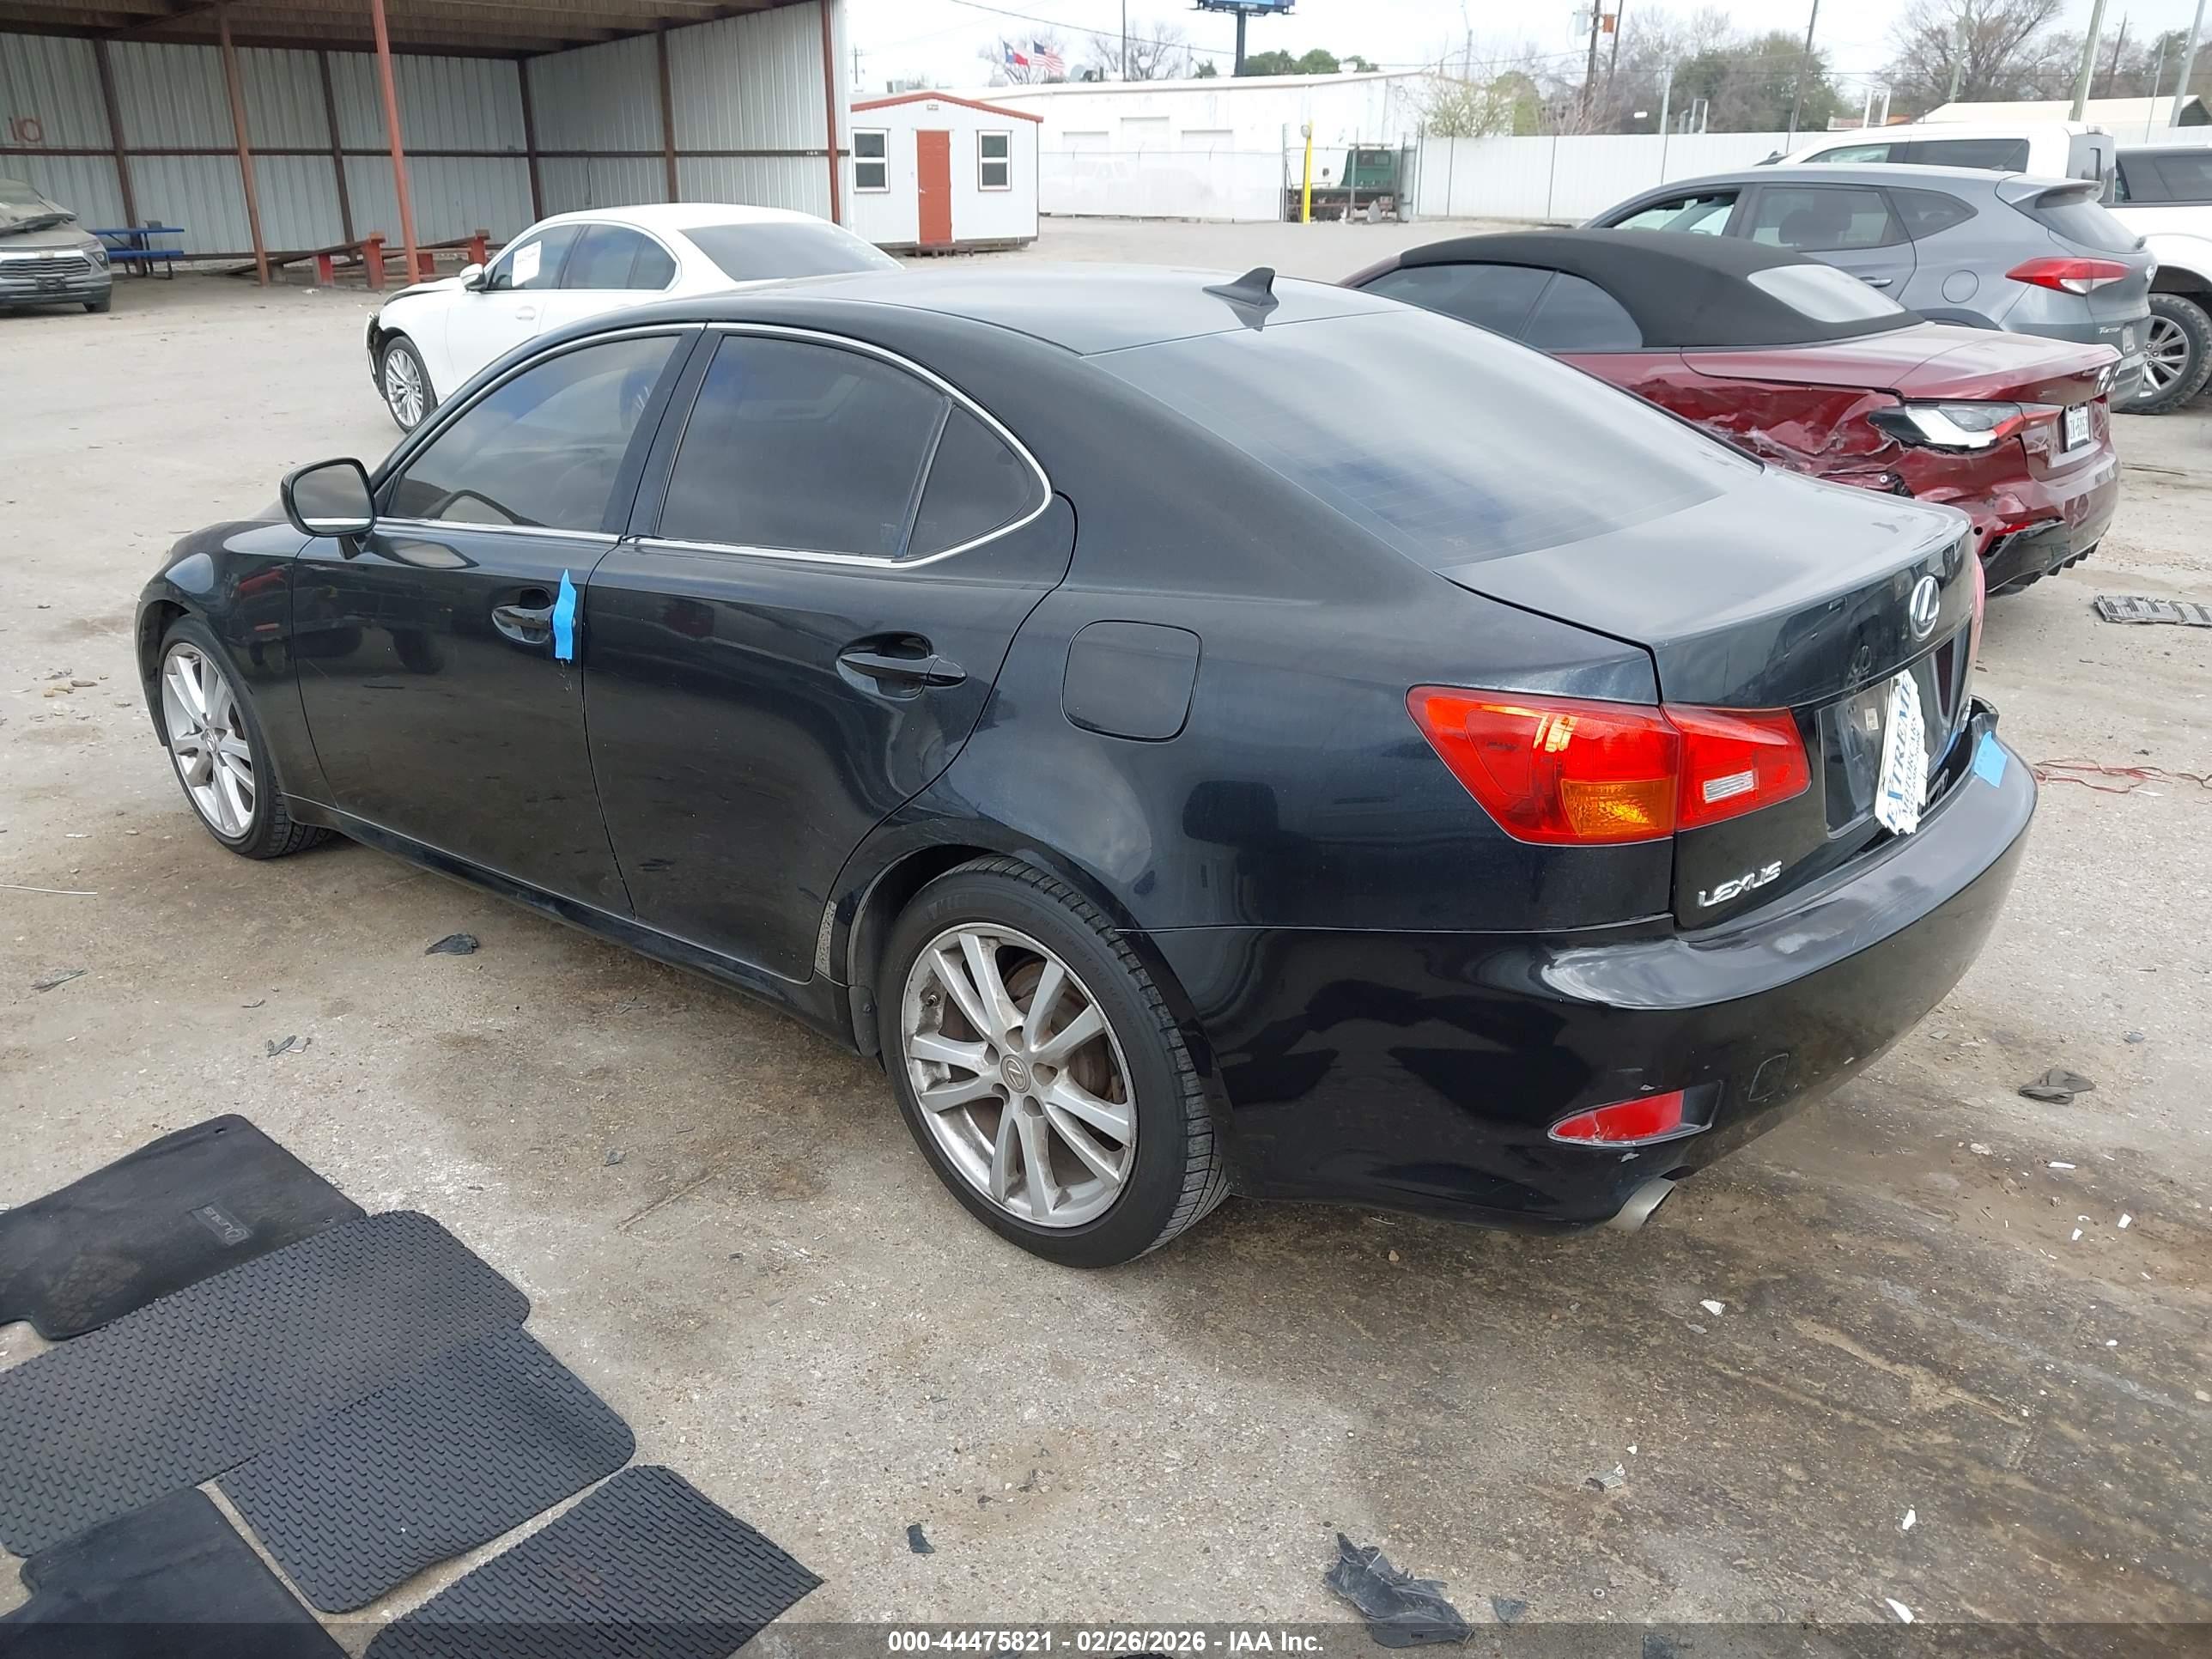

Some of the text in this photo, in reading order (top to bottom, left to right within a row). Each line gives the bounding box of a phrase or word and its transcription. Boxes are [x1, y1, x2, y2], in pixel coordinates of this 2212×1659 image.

[1887, 673, 1912, 826] EXTREME
[1902, 714, 1917, 818] MOTORCARS
[1698, 860, 1783, 907] LEXUS
